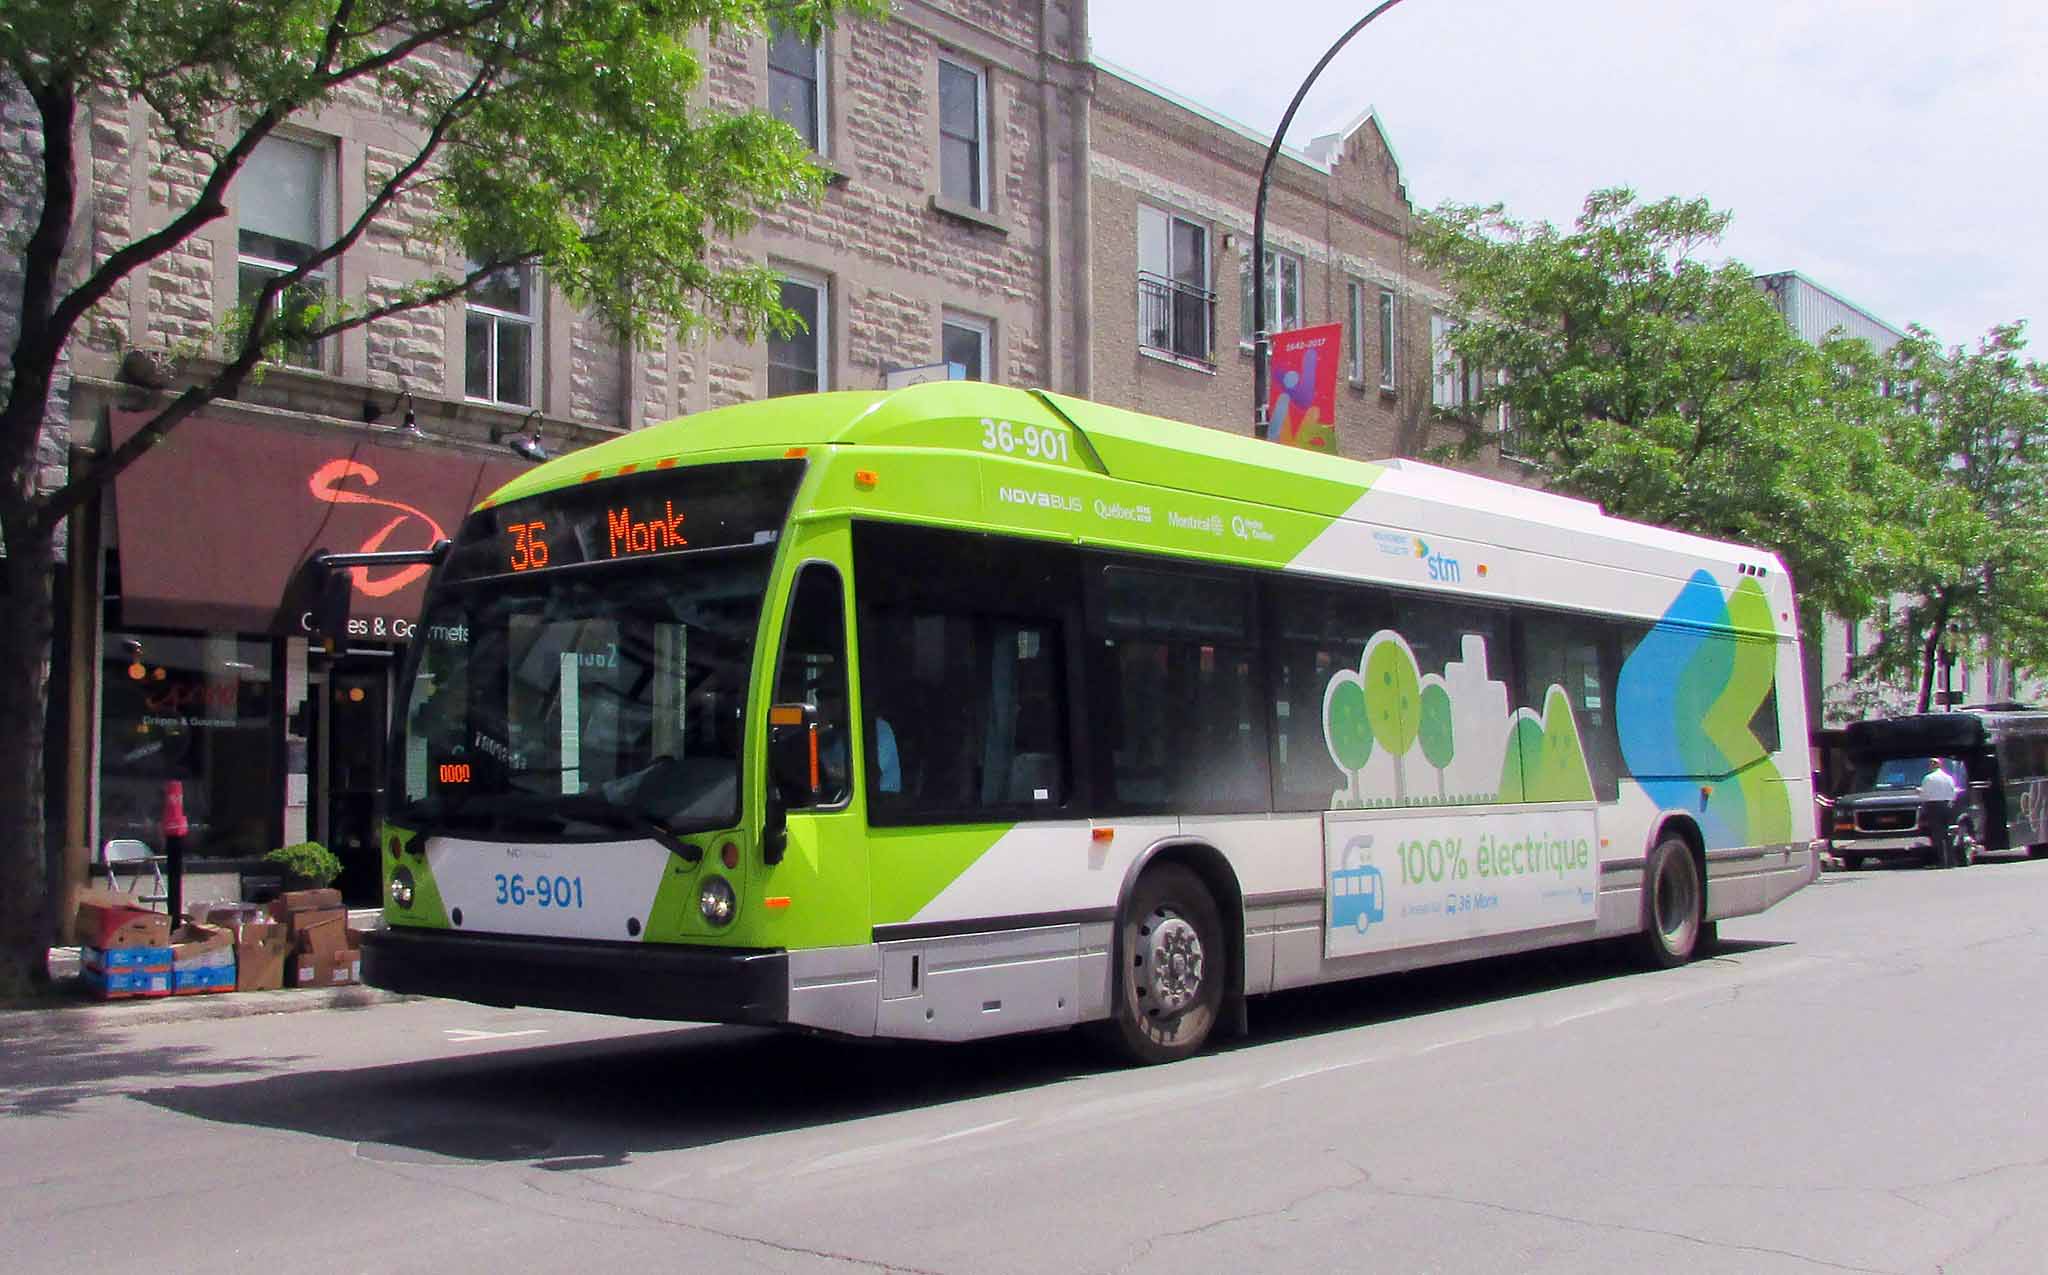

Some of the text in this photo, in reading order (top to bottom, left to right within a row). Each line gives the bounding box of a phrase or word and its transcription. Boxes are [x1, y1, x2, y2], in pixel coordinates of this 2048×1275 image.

[980, 417, 1069, 463] 36-901
[507, 499, 688, 571] 36 Monk
[1428, 552, 1461, 584] stm
[373, 617, 387, 637] &
[1397, 832, 1588, 885] 100% électrique
[495, 873, 583, 909] 36-901
